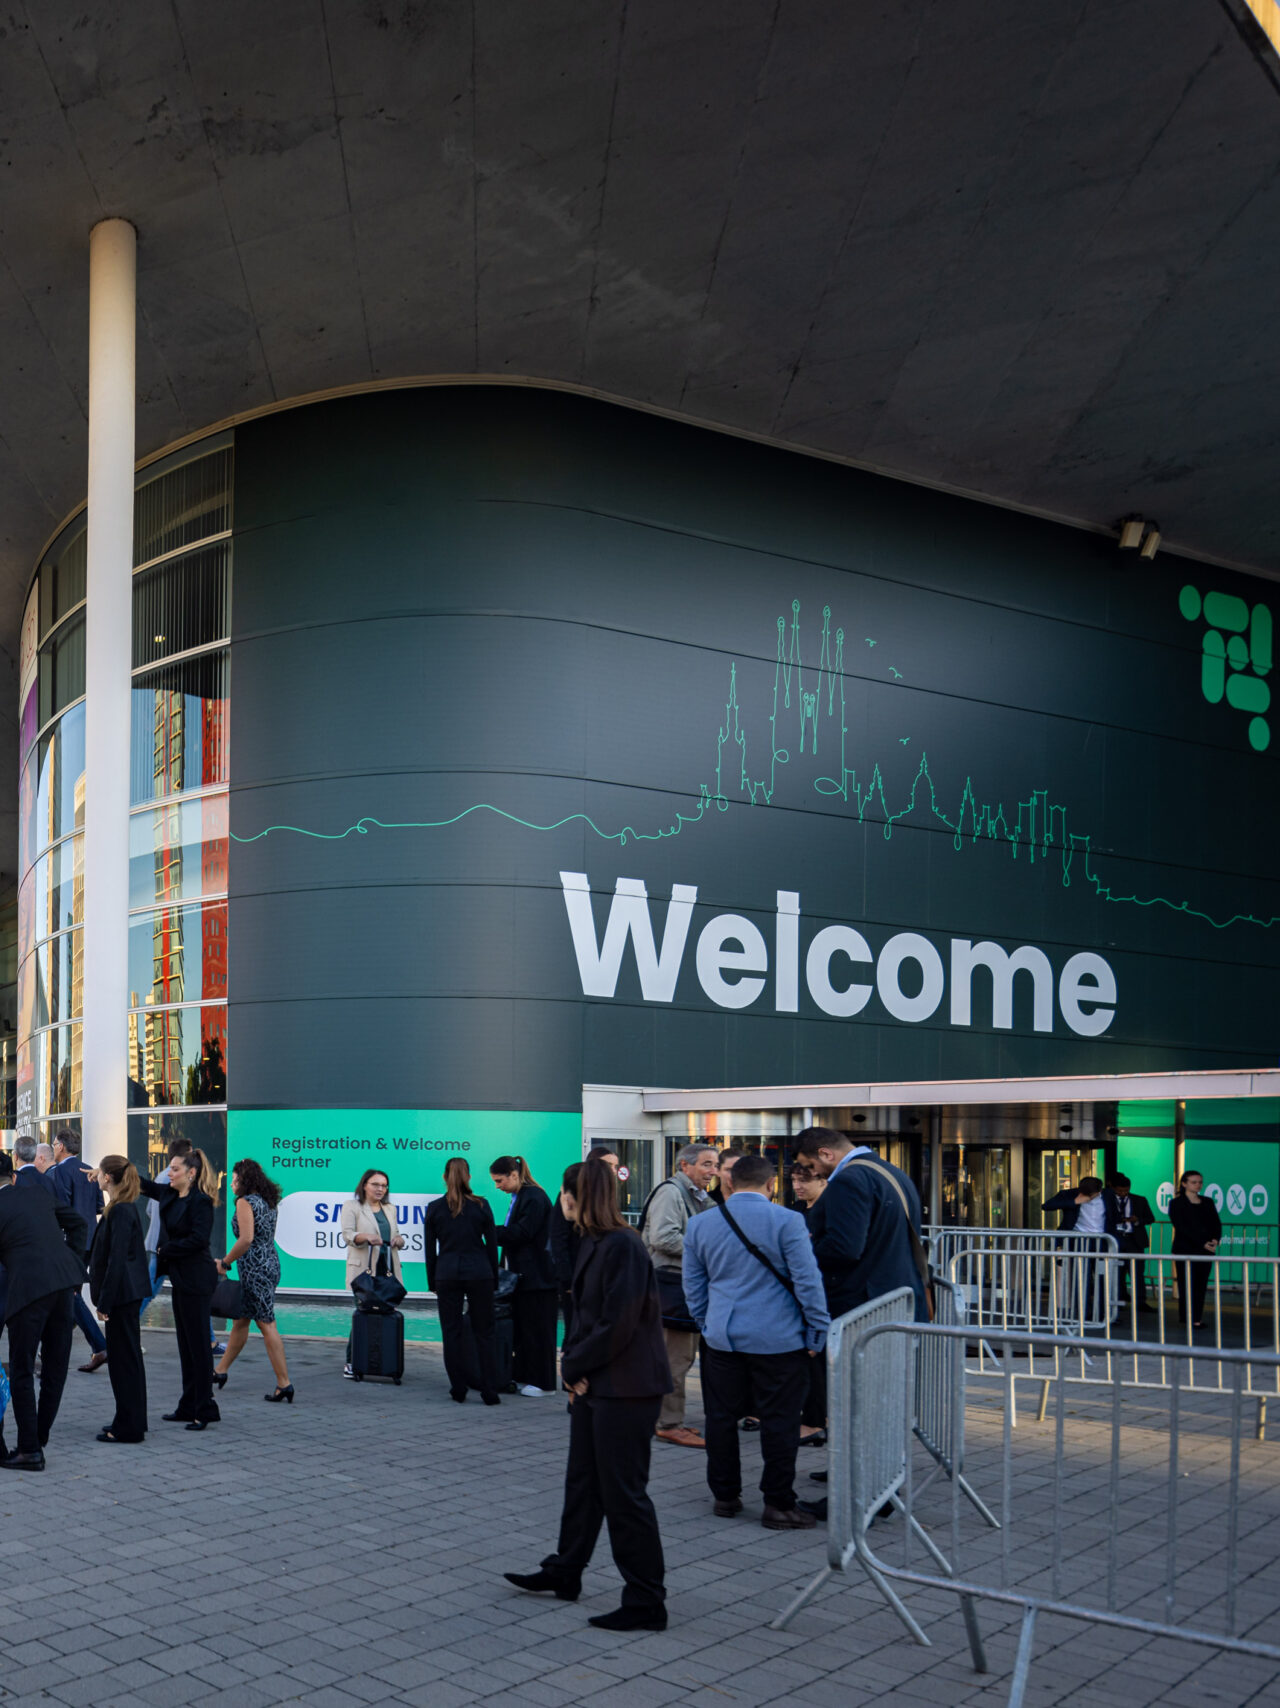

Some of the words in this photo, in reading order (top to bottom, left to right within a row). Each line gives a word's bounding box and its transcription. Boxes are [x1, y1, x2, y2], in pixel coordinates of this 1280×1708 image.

[559, 870, 1118, 1037] Welcome
[271, 1136, 371, 1153] Registration
[376, 1137, 387, 1150] &
[393, 1137, 471, 1151] Welcome
[272, 1155, 332, 1168] Partner
[314, 1203, 426, 1225] SAUN
